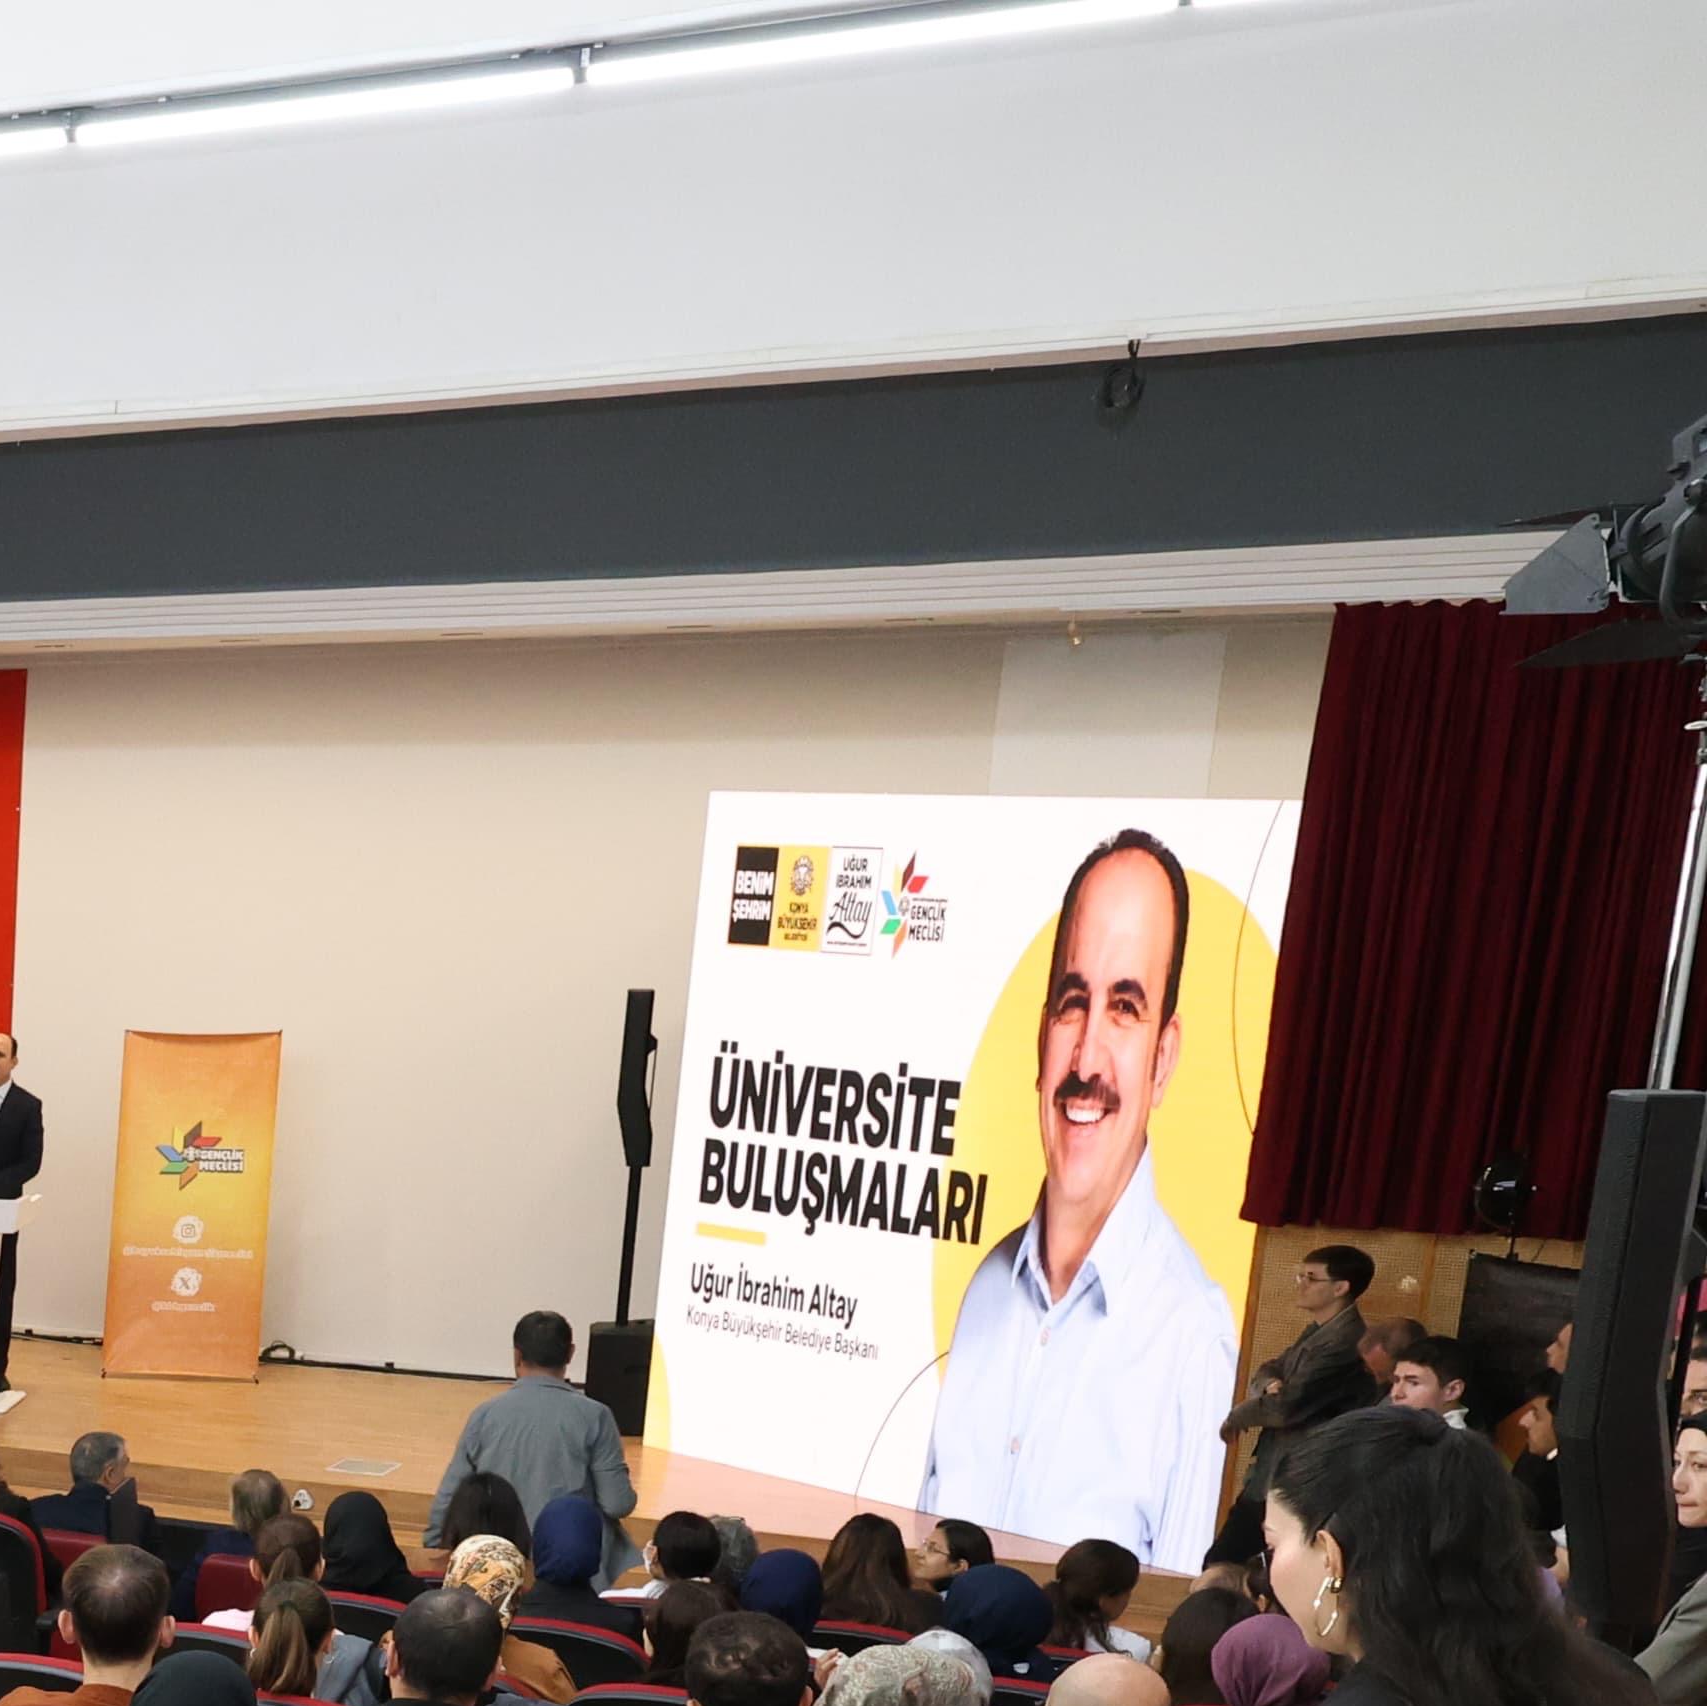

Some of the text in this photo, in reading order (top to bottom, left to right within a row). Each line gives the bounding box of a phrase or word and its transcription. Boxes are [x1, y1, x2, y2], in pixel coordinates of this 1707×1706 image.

[710, 1040, 961, 1156] ÜNİVERSİTE
[699, 1137, 988, 1245] BULUŞMALARI
[686, 1304, 880, 1360] Konya Büyükşehir Belediye Başkanı
[690, 1262, 858, 1330] Uğur İbrahim Altay
